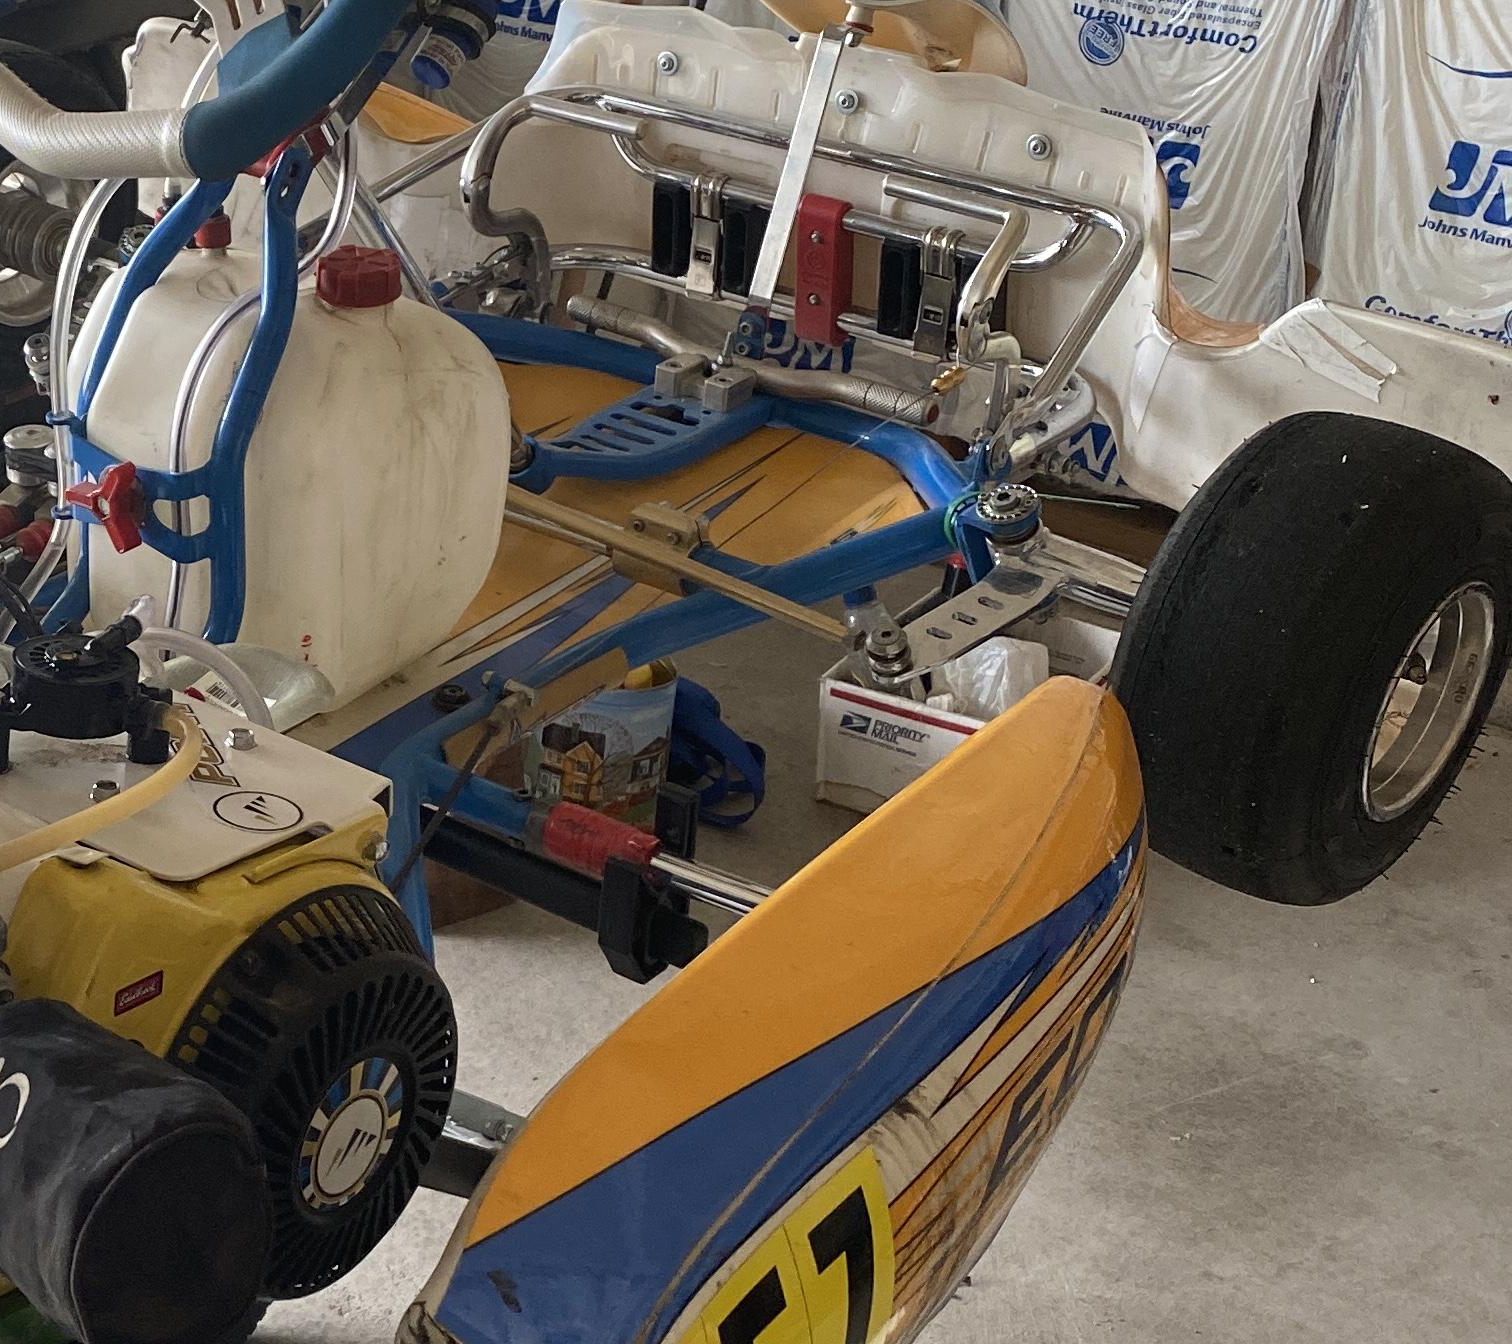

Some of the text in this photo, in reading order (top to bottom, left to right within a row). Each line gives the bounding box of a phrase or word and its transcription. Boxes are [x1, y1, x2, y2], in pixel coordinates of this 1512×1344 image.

[1126, 1, 1156, 16] Glass
[1217, 4, 1263, 18] Thermal
[1073, 2, 1258, 54] ComfortTherm
[1188, 11, 1262, 30] Encapsulated
[1166, 122, 1212, 140] Johns
[1417, 215, 1512, 249] Johns Manv
[871, 728, 899, 745] MAIL
[873, 719, 926, 743] PRIORITY
